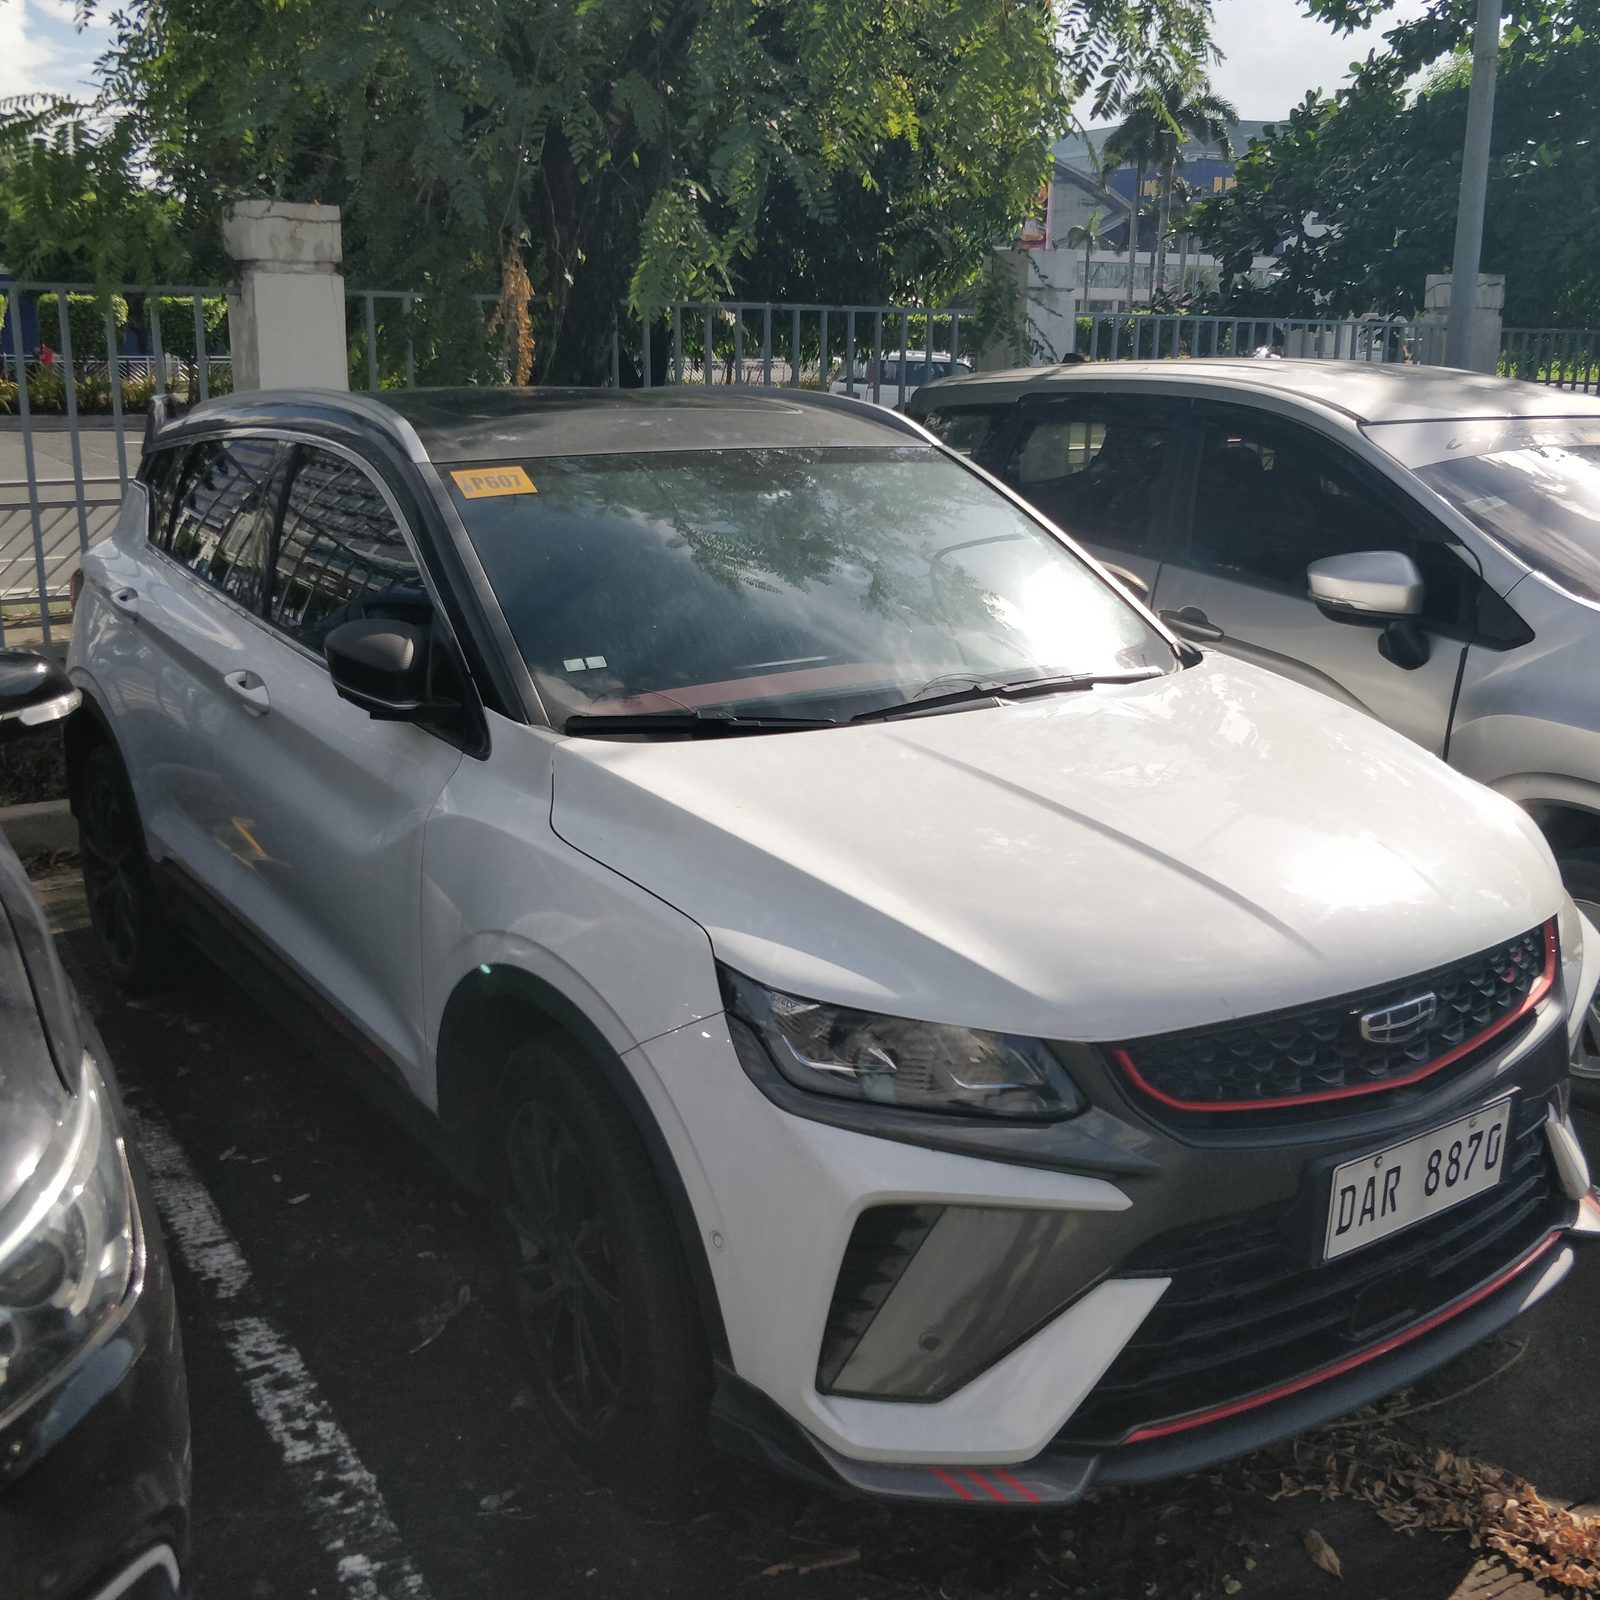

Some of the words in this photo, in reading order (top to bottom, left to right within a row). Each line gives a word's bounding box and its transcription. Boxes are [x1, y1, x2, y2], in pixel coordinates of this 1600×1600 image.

[469, 474, 522, 490] P607
[1335, 1165, 1401, 1236] DAR
[1424, 1122, 1502, 1197] 8870
